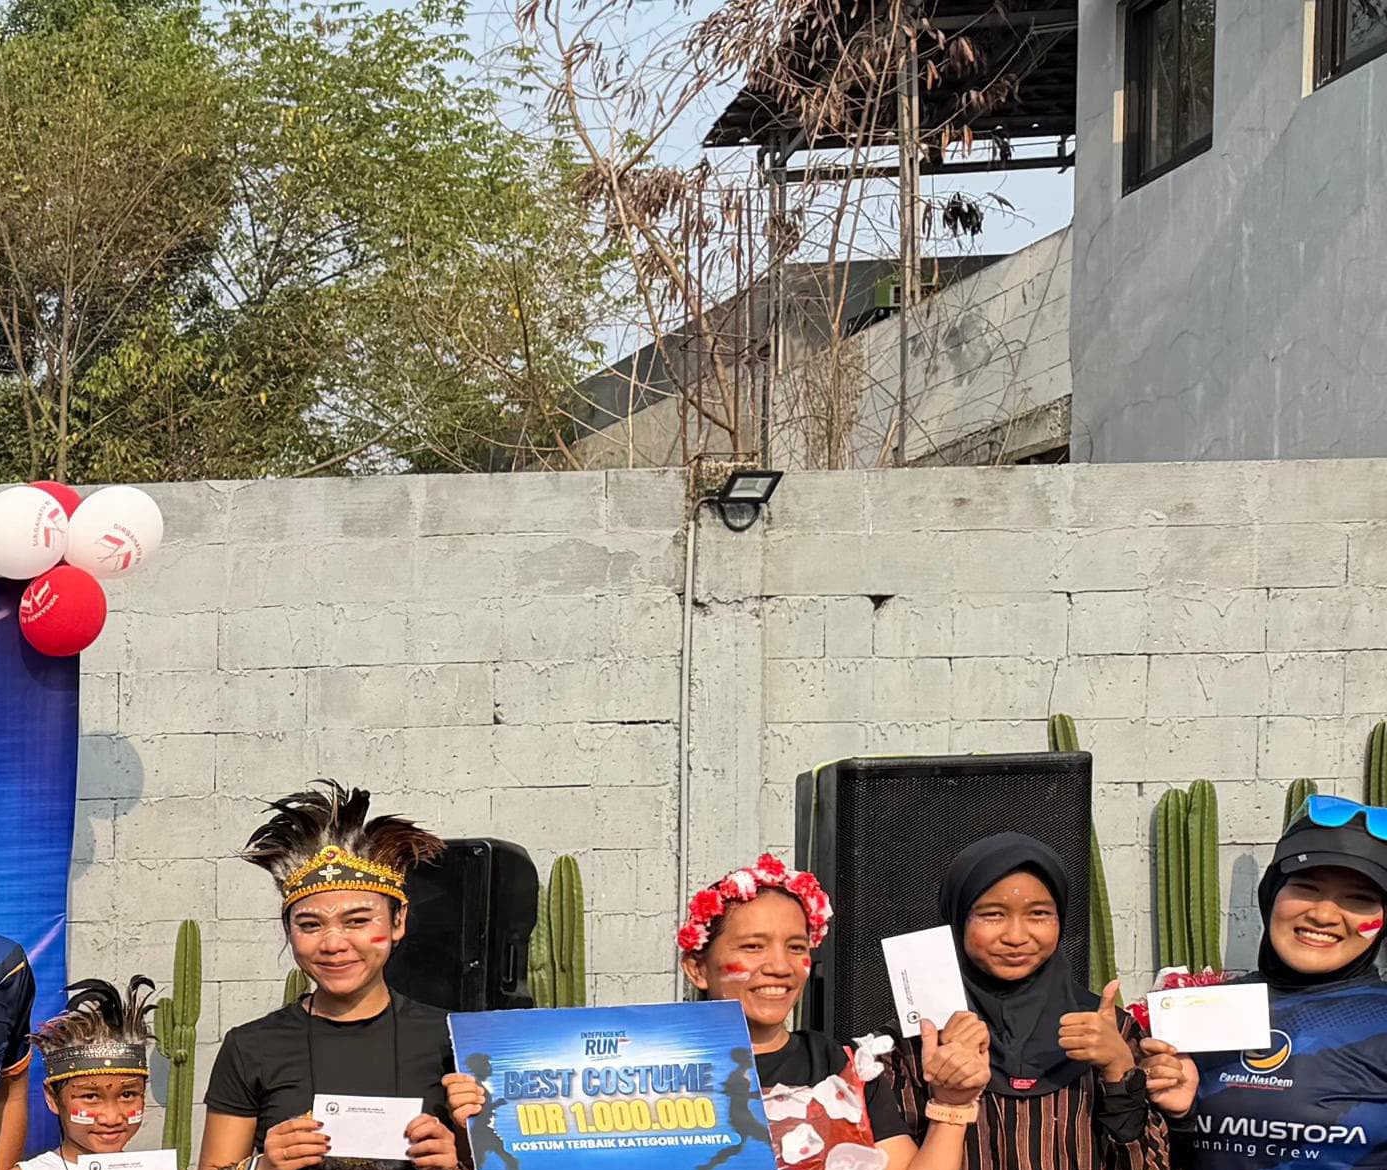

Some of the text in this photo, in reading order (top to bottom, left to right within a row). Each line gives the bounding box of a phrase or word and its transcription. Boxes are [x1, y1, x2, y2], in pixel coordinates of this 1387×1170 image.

[584, 1038, 619, 1056] RUN
[503, 1062, 714, 1100] BEST COSTUME
[1250, 1074, 1294, 1088] NasDem
[516, 1097, 717, 1135] IDR 1.000.000
[1219, 1116, 1367, 1145] MUSTOPA
[512, 1134, 732, 1152] KOSTUM TERBAIK KATEGORI WANITA
[1193, 1139, 1320, 1159] unning Crew
